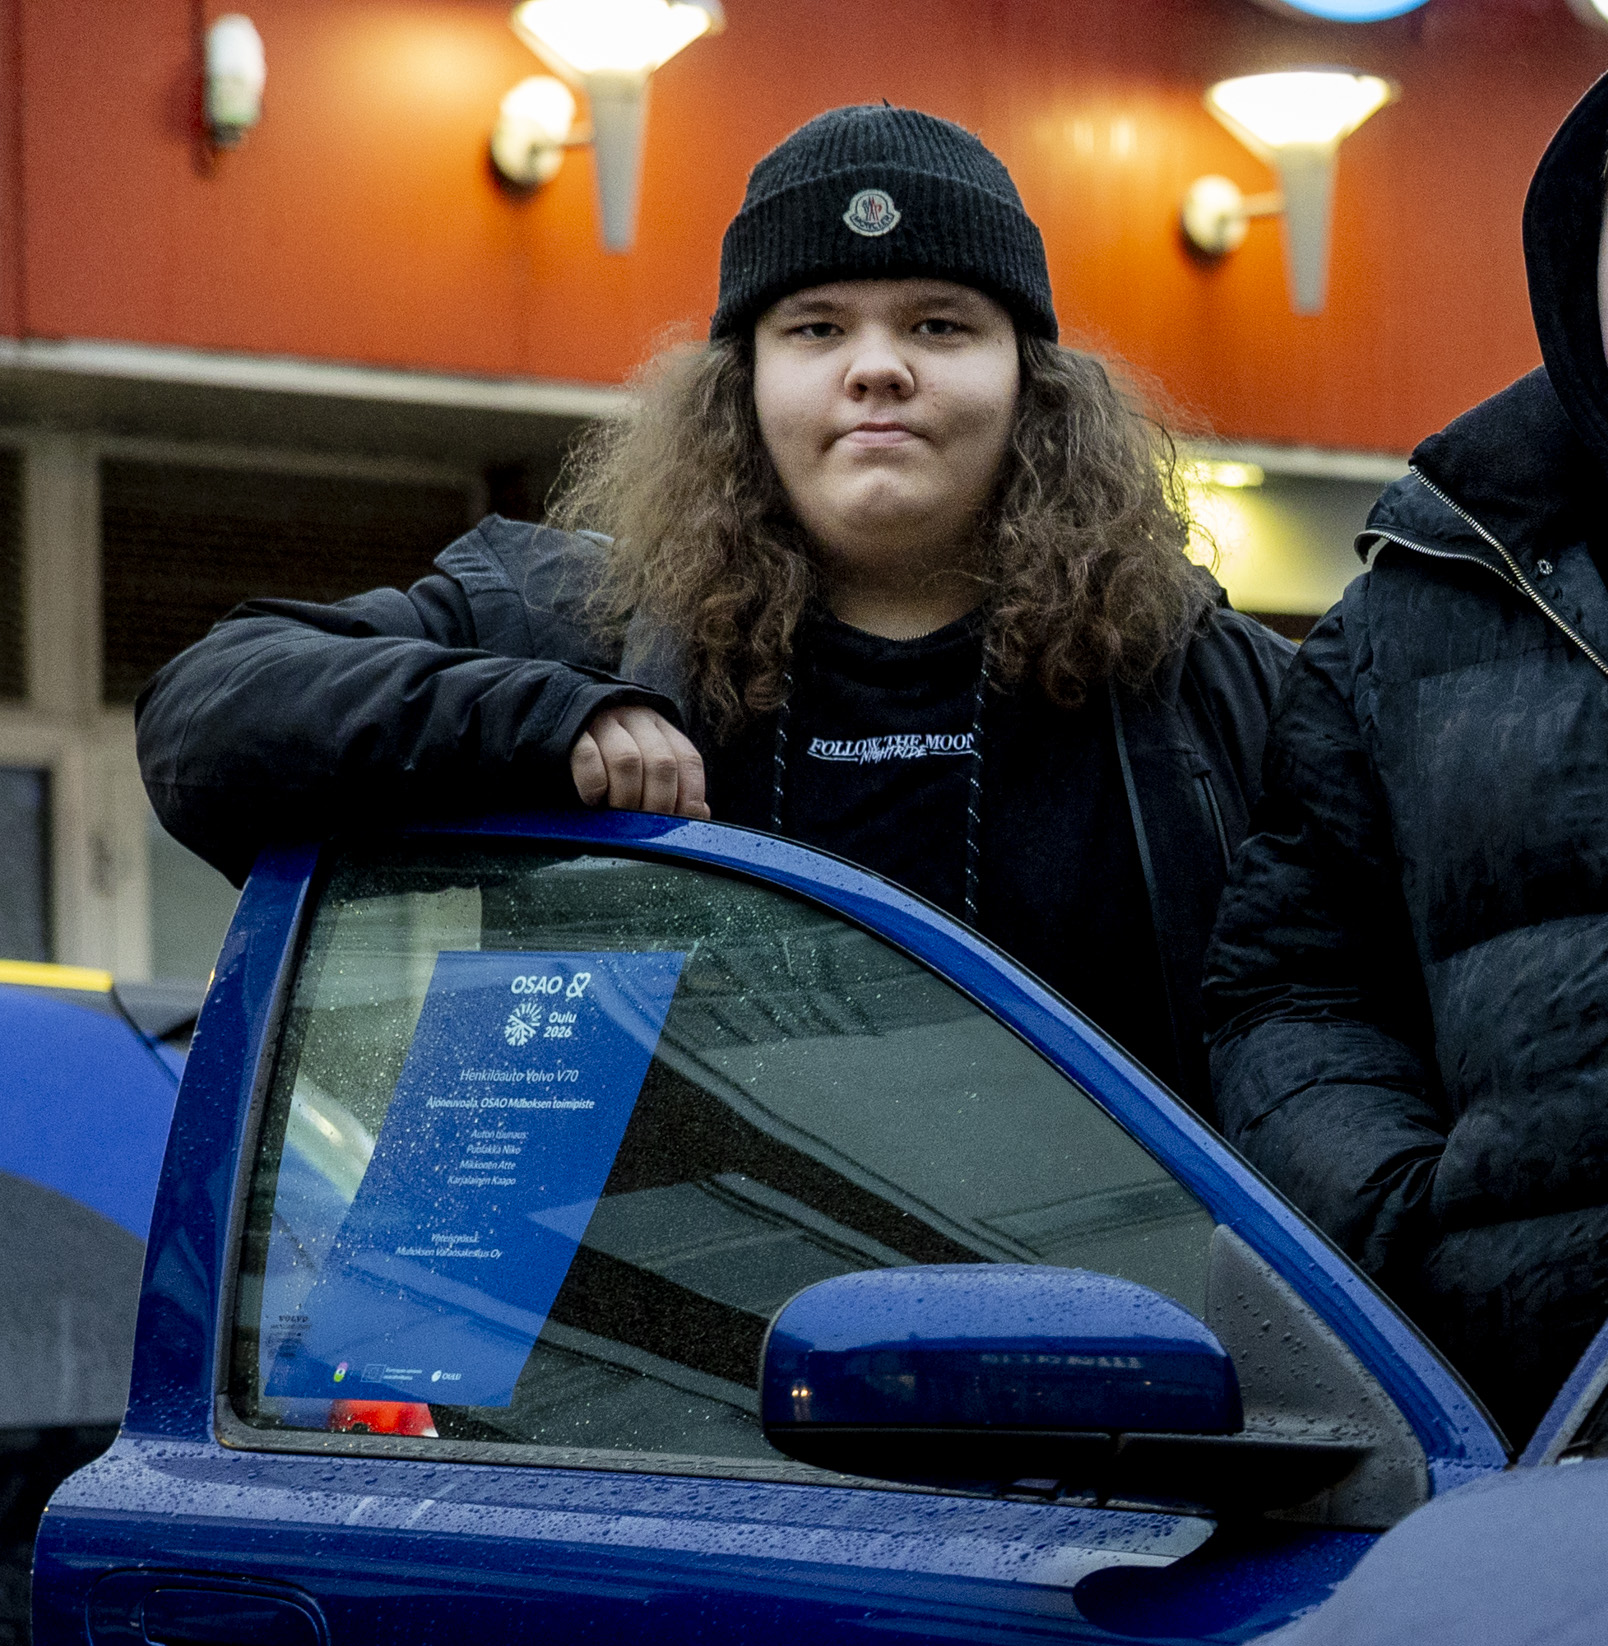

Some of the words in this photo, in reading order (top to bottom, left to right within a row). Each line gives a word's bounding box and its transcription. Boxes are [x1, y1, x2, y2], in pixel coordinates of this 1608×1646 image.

[809, 737, 882, 756] FOLLOW
[884, 734, 922, 748] THE
[859, 745, 928, 765] NIGHTRIDE
[511, 976, 563, 994] OSAO
[548, 1011, 577, 1024] Oulu
[543, 1026, 572, 1038] 2026
[526, 1069, 554, 1082] Volvo
[557, 1069, 579, 1082] V70
[481, 1098, 508, 1108] OSAO
[553, 1097, 595, 1111] toimipiste
